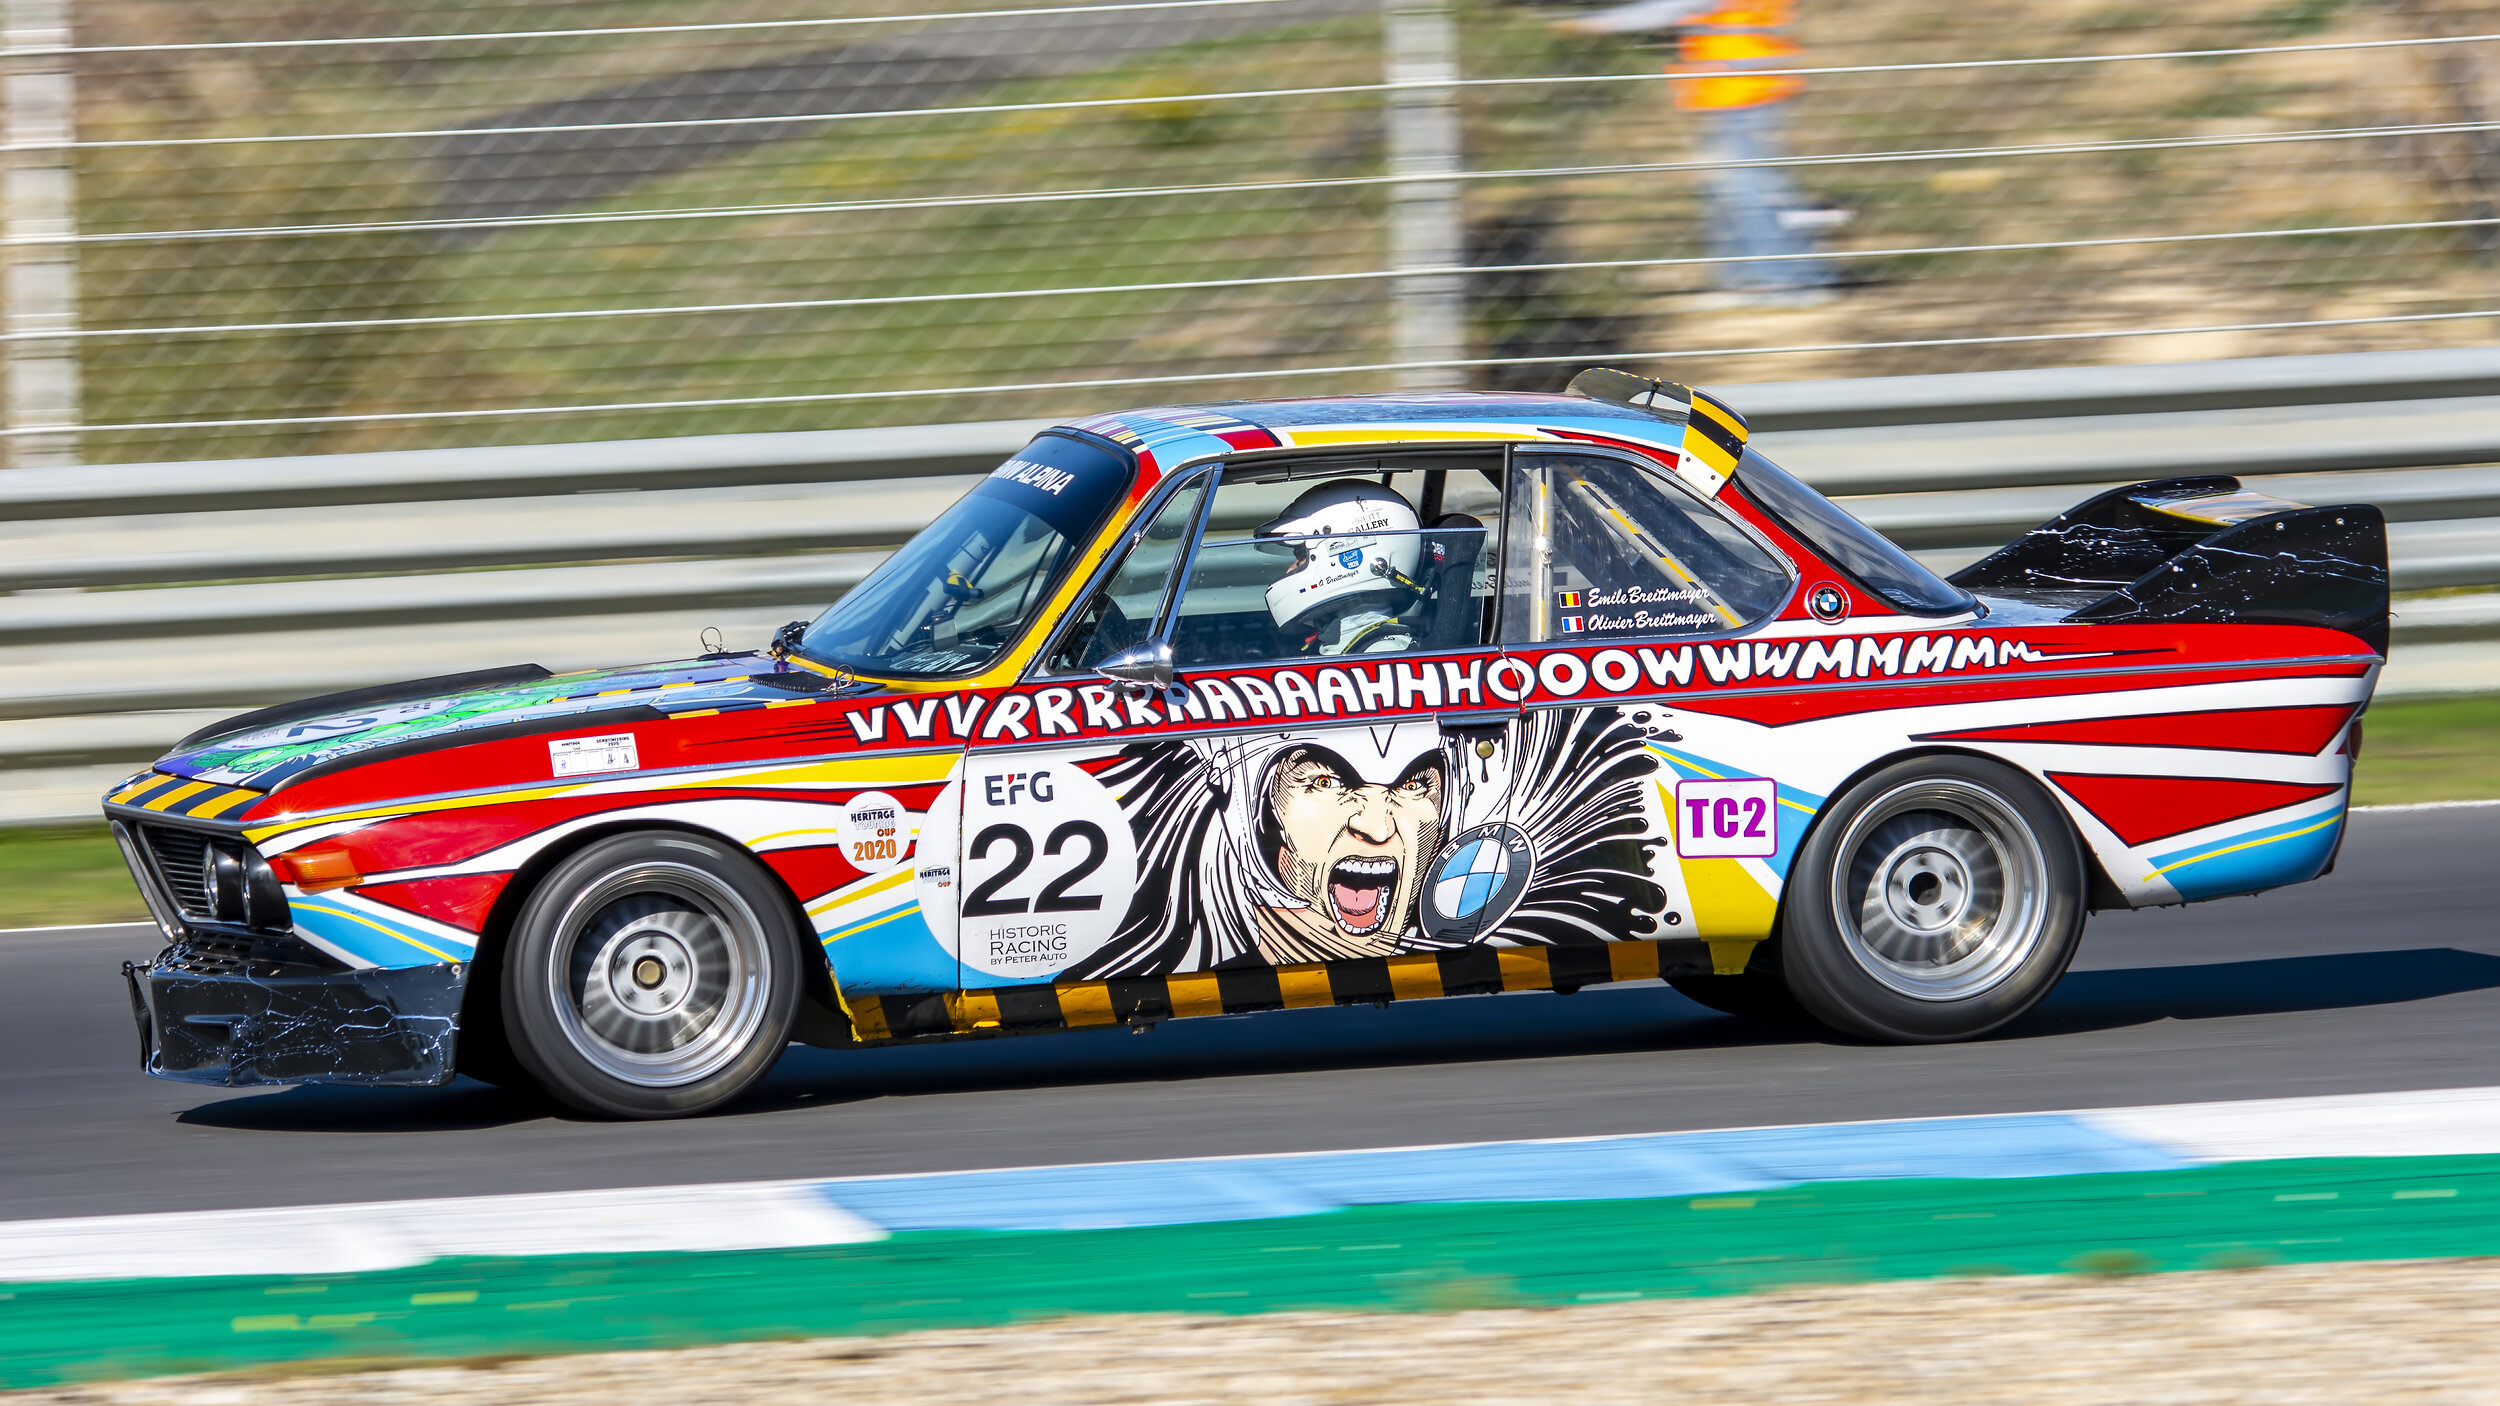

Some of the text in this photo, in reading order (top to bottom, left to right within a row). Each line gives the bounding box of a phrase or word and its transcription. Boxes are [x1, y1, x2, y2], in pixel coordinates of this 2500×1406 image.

[1011, 463, 1075, 496] ALPINA
[1348, 518, 1389, 533] GALLERY
[1587, 585, 1711, 608] Emile Breittmayer
[1587, 610, 1717, 631] Olivier Breittmayer
[985, 771, 1053, 807] EFG
[850, 809, 895, 823] HERITAGE
[854, 819, 896, 831] TOURING
[1685, 796, 1767, 838] TC2
[876, 827, 896, 837] CUP
[853, 838, 897, 862] 2020
[1441, 824, 1527, 861] BMW
[919, 868, 950, 878] HERITAGE
[961, 819, 1109, 918] 22
[937, 880, 951, 888] CUP
[990, 923, 1067, 940] HISTORIC
[990, 936, 1067, 956] RACING
